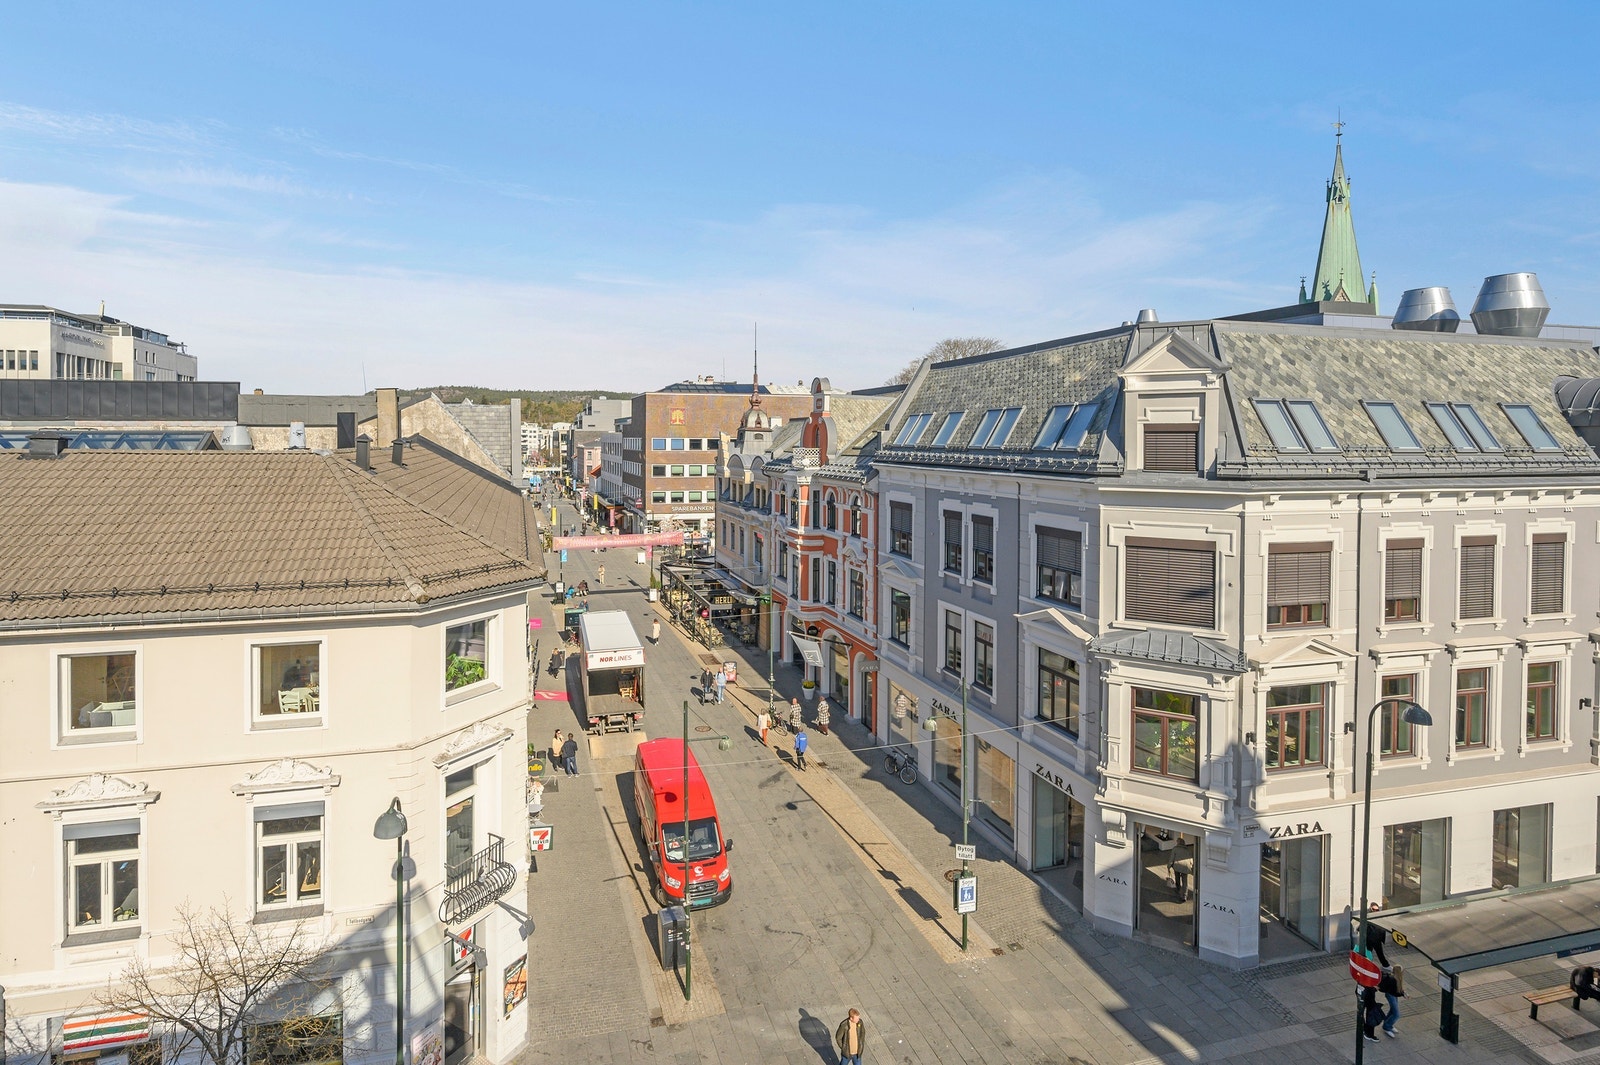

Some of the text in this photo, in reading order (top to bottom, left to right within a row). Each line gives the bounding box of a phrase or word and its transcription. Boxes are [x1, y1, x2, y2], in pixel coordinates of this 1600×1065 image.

[932, 698, 957, 720] ZARA
[1036, 763, 1075, 796] ZARA
[533, 829, 549, 851] 7
[1269, 821, 1325, 839] ZARA
[1099, 875, 1128, 886] ZARA
[1203, 901, 1235, 915] ZARA
